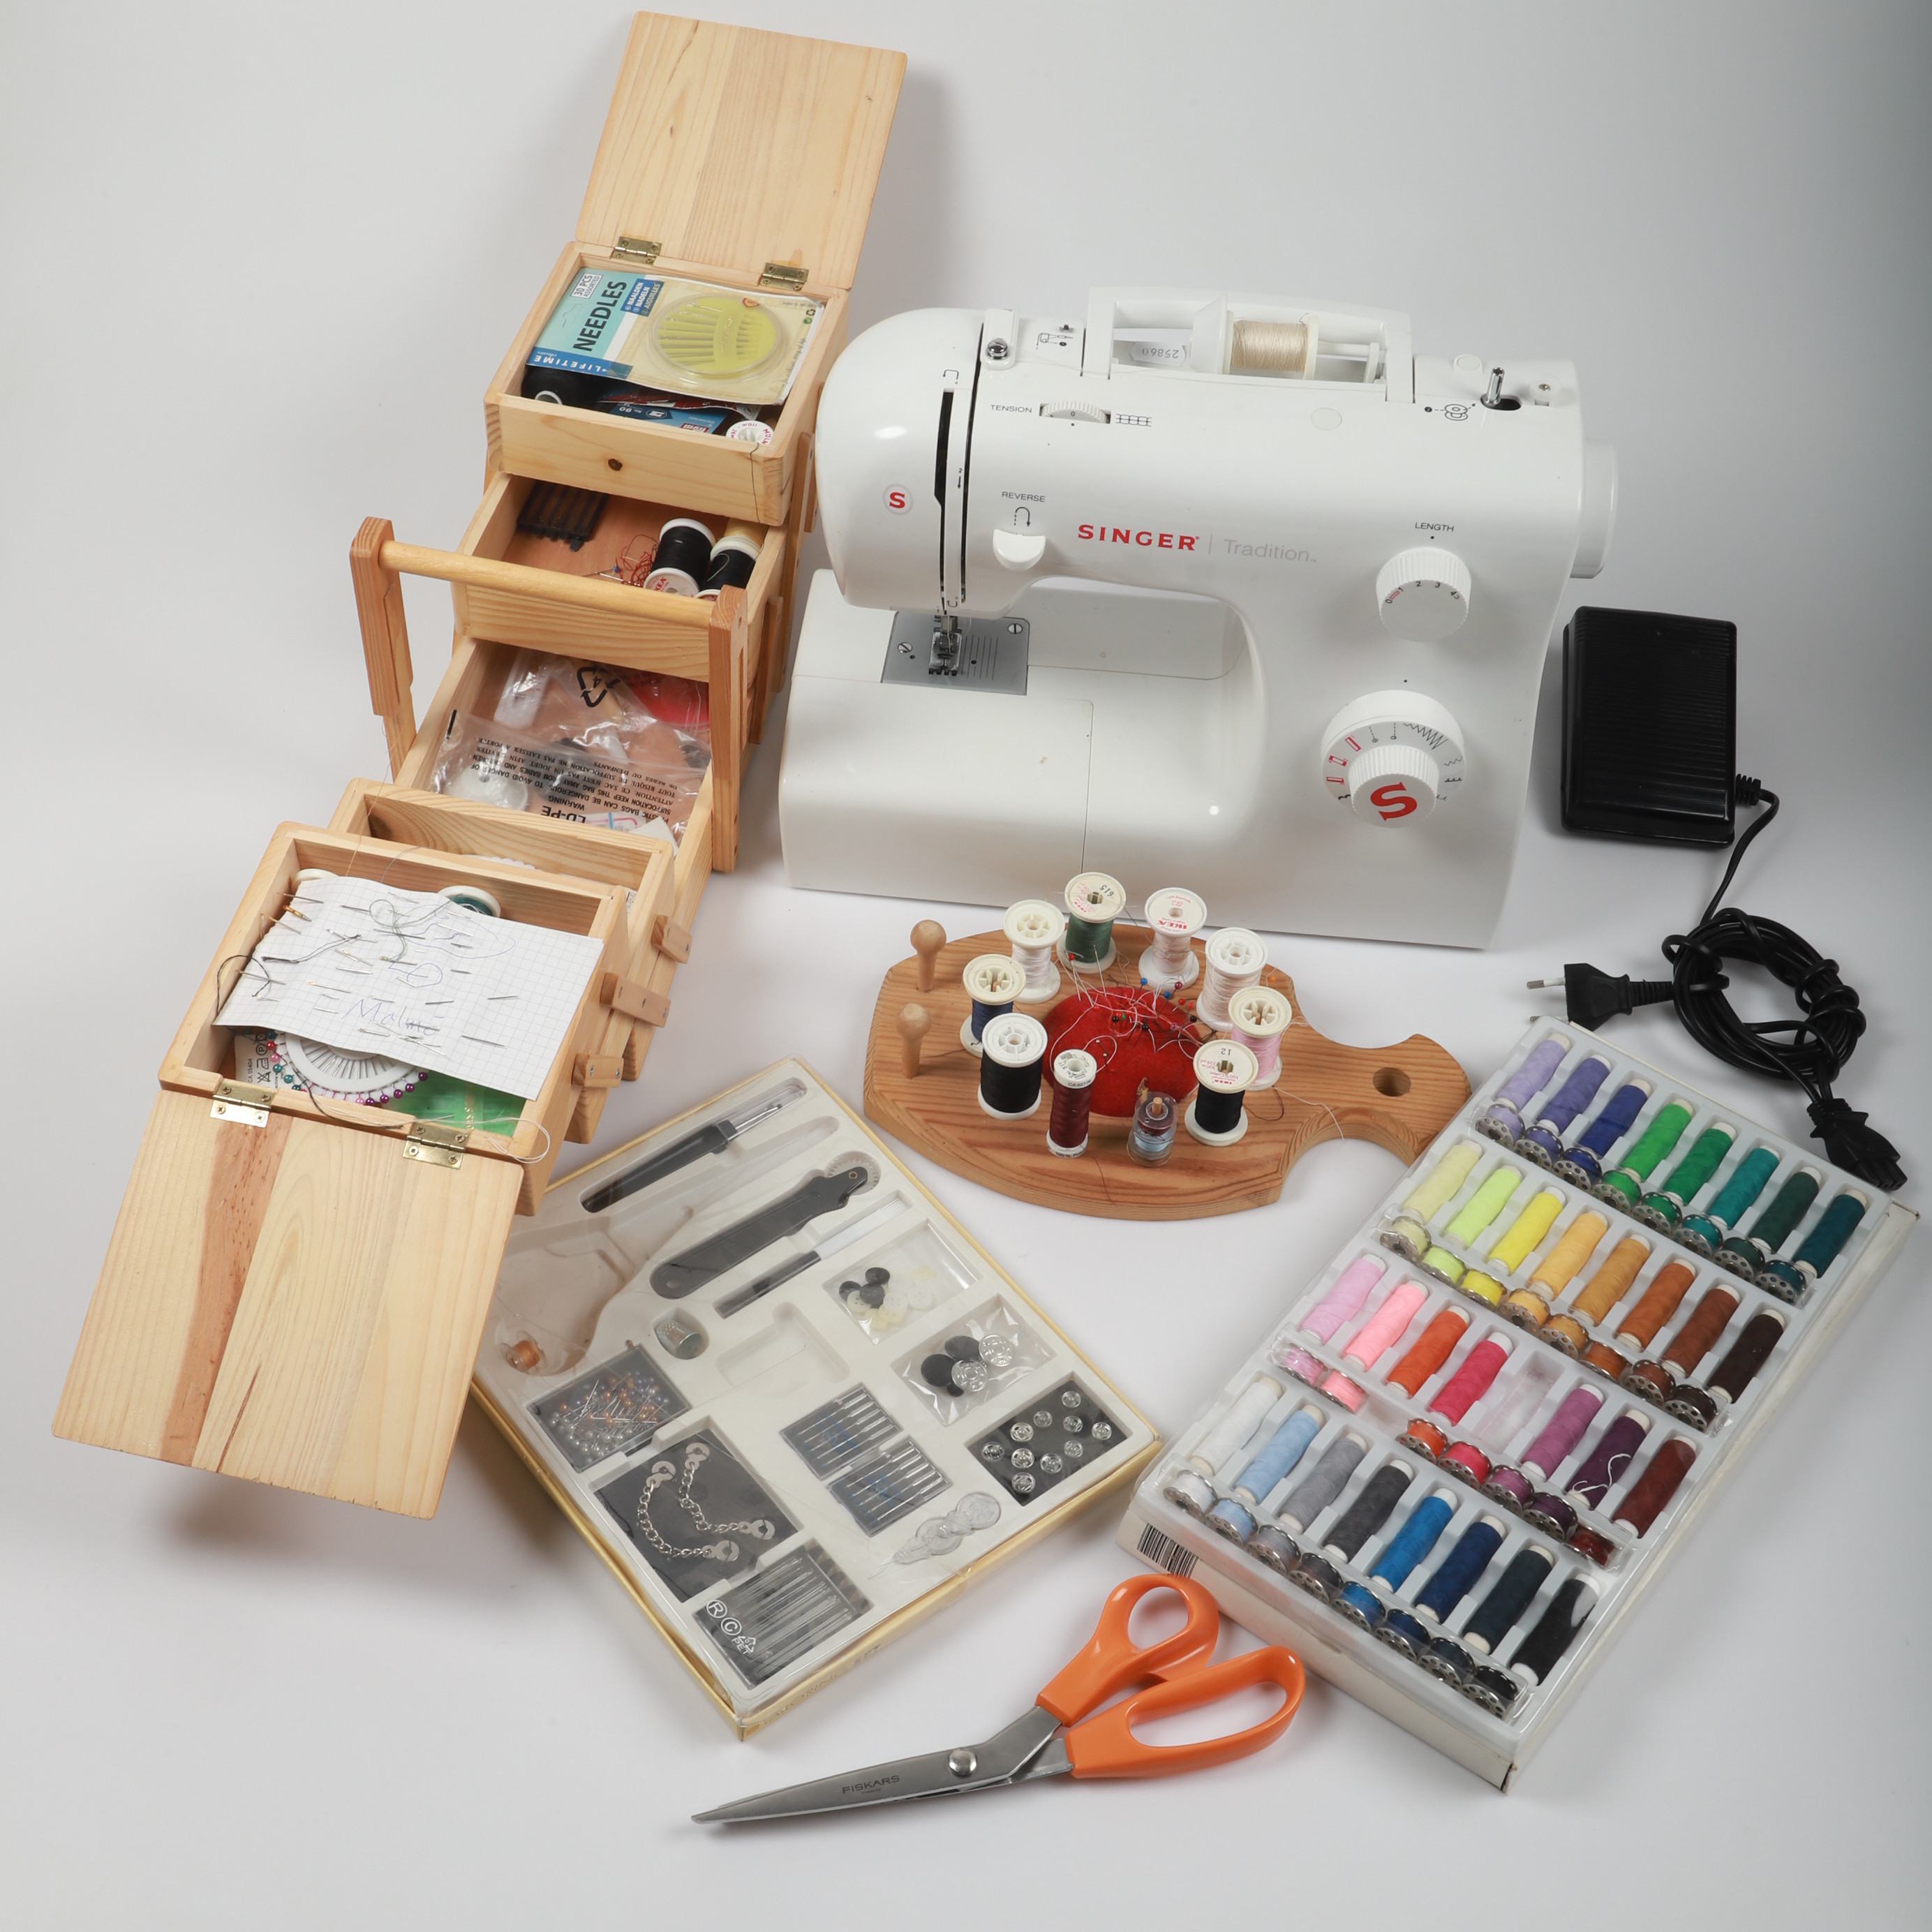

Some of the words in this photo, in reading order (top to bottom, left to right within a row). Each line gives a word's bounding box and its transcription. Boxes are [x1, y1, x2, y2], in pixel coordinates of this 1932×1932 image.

[574, 285, 584, 296] 30
[580, 275, 593, 290] PCS
[584, 276, 600, 297] ASSORTED
[627, 282, 644, 305] NAALDEN
[635, 286, 650, 307] NADELN
[644, 283, 660, 309] AIGUILLES
[572, 281, 627, 352] NEEDLES
[534, 355, 603, 373] LIFETIME
[990, 404, 1032, 413] TENSION
[889, 492, 905, 508] S
[1002, 491, 1046, 503] REVERSE
[1415, 522, 1454, 532] LENGTH
[1078, 524, 1197, 551] SINGER
[654, 577, 667, 590] KEA
[513, 746, 540, 758] LAISSER
[503, 761, 517, 770] AND
[509, 755, 526, 764] AFIN
[529, 760, 551, 771] JOUET
[542, 755, 555, 763] PAS
[481, 765, 510, 778] DANGER
[519, 766, 541, 778] BABIES
[542, 773, 560, 782] ROM
[566, 771, 579, 779] PAS
[570, 762, 616, 780] SUFFOCATION
[512, 773, 532, 785] AVOID
[563, 779, 579, 788] AWAY
[630, 779, 655, 792] RISQUE
[547, 784, 589, 801] DANGEROUS
[581, 785, 595, 793] BAG
[604, 782, 618, 790] SAC
[657, 787, 675, 797] TOUT
[597, 789, 610, 797] THIS
[613, 793, 629, 803] KEEP
[633, 790, 673, 806] ATTENTION:
[547, 794, 585, 810] WARNING
[603, 800, 618, 809] CAN
[631, 798, 671, 815] SUFFOCATION
[1370, 782, 1418, 822] S
[541, 805, 586, 824] LD-PE
[621, 805, 639, 815] BAGS
[641, 811, 669, 824] PSTIC
[1099, 884, 1114, 897] 615
[1158, 920, 1187, 930] IKEA
[731, 1637, 751, 1655] PET
[842, 1776, 900, 1794] FISKARS
